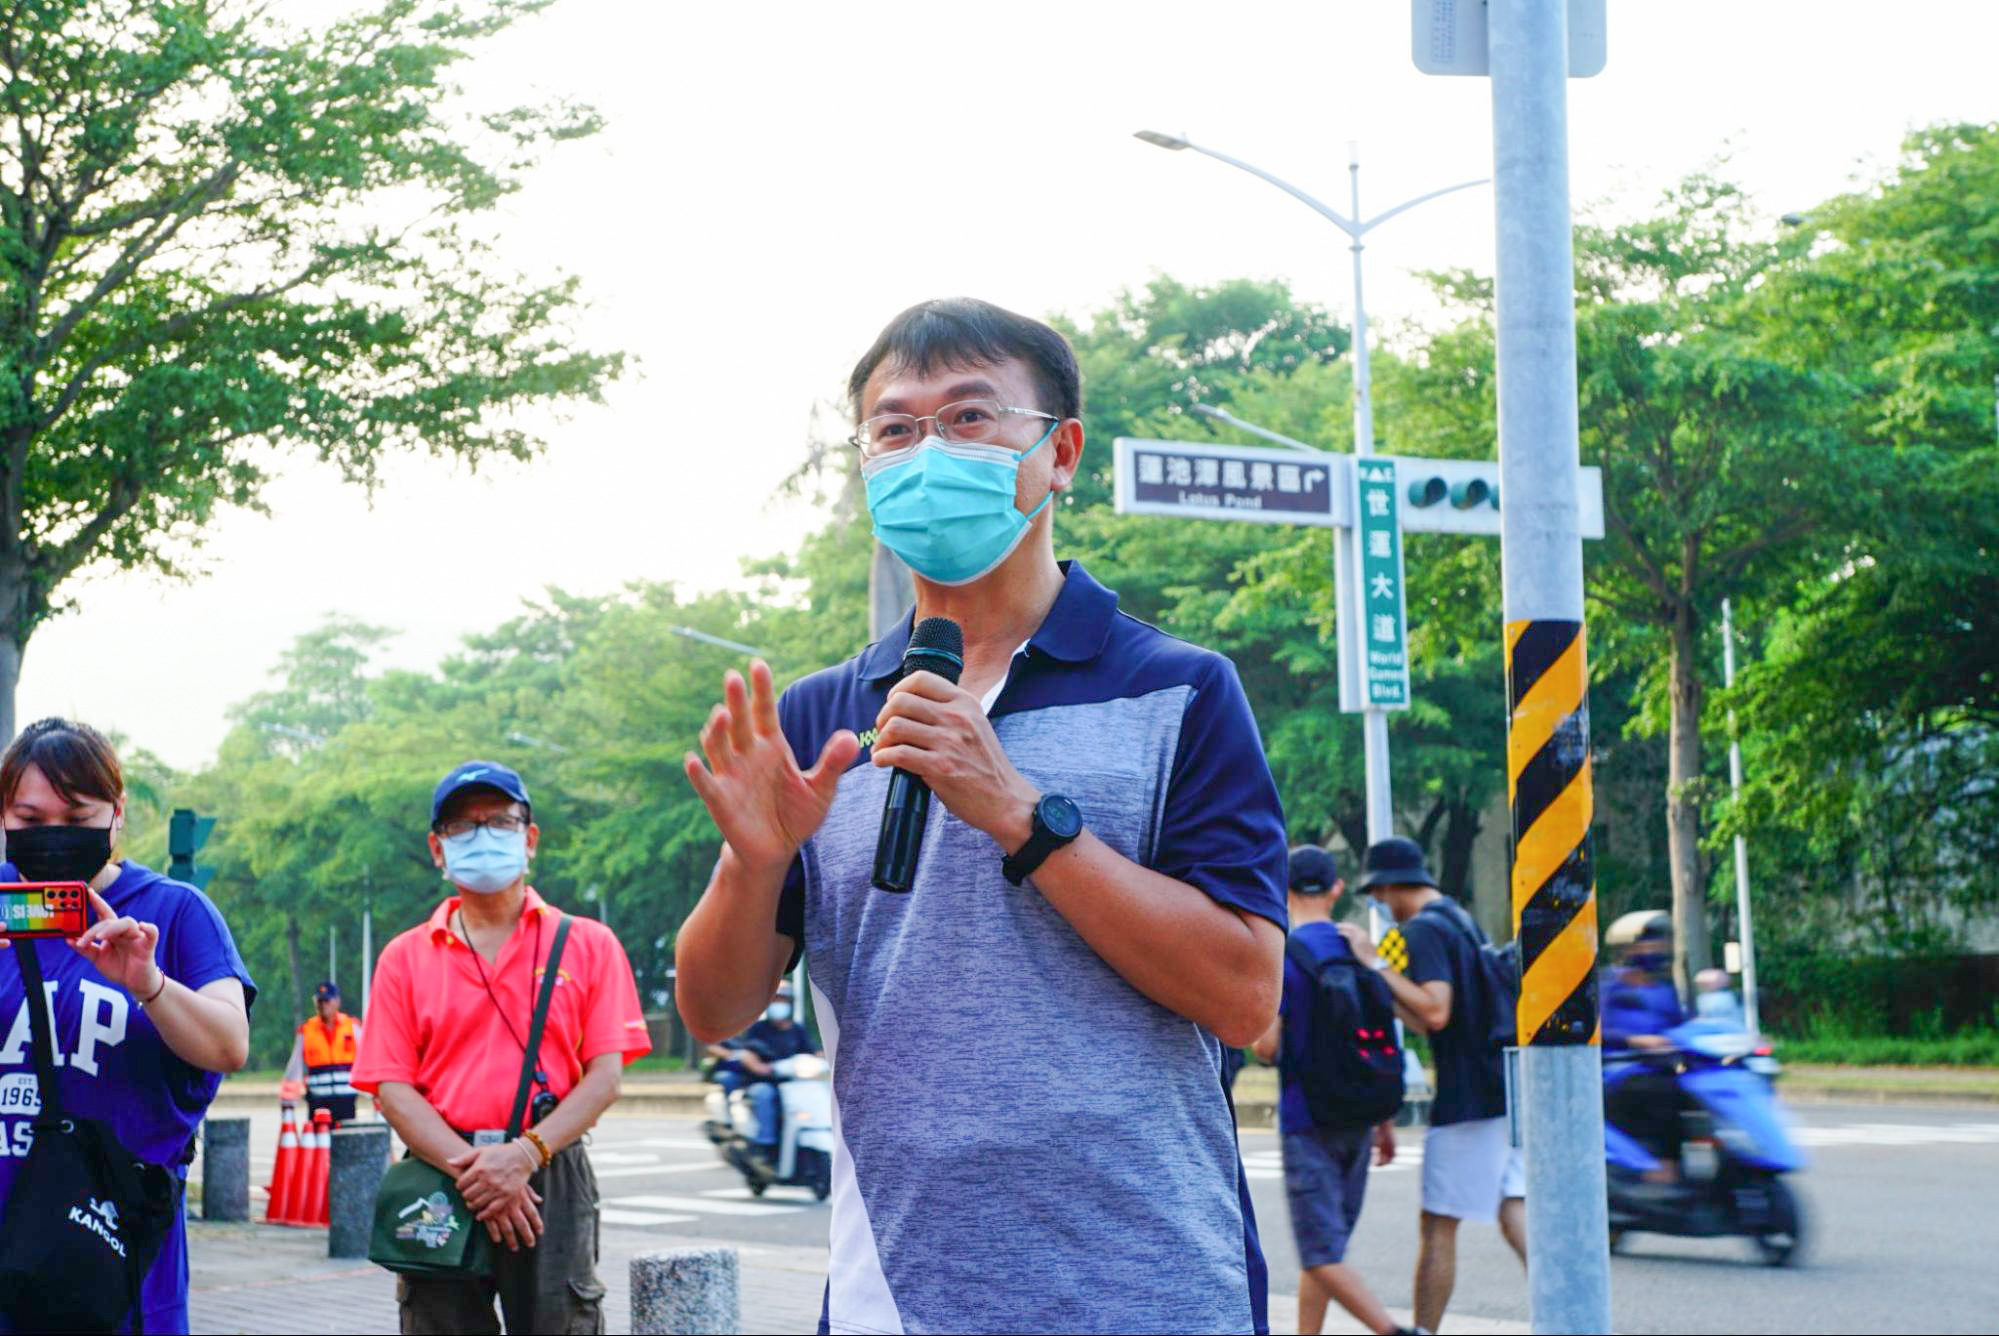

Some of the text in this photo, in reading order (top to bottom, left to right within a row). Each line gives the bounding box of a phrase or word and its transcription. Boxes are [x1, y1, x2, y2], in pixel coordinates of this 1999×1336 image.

[1138, 454, 1301, 493] 蓮池潭風景區
[1178, 489, 1263, 509] Lotus Pond
[1366, 488, 1396, 642] 世運大道
[1371, 651, 1403, 665] World
[69, 1206, 127, 1257] KANGOL
